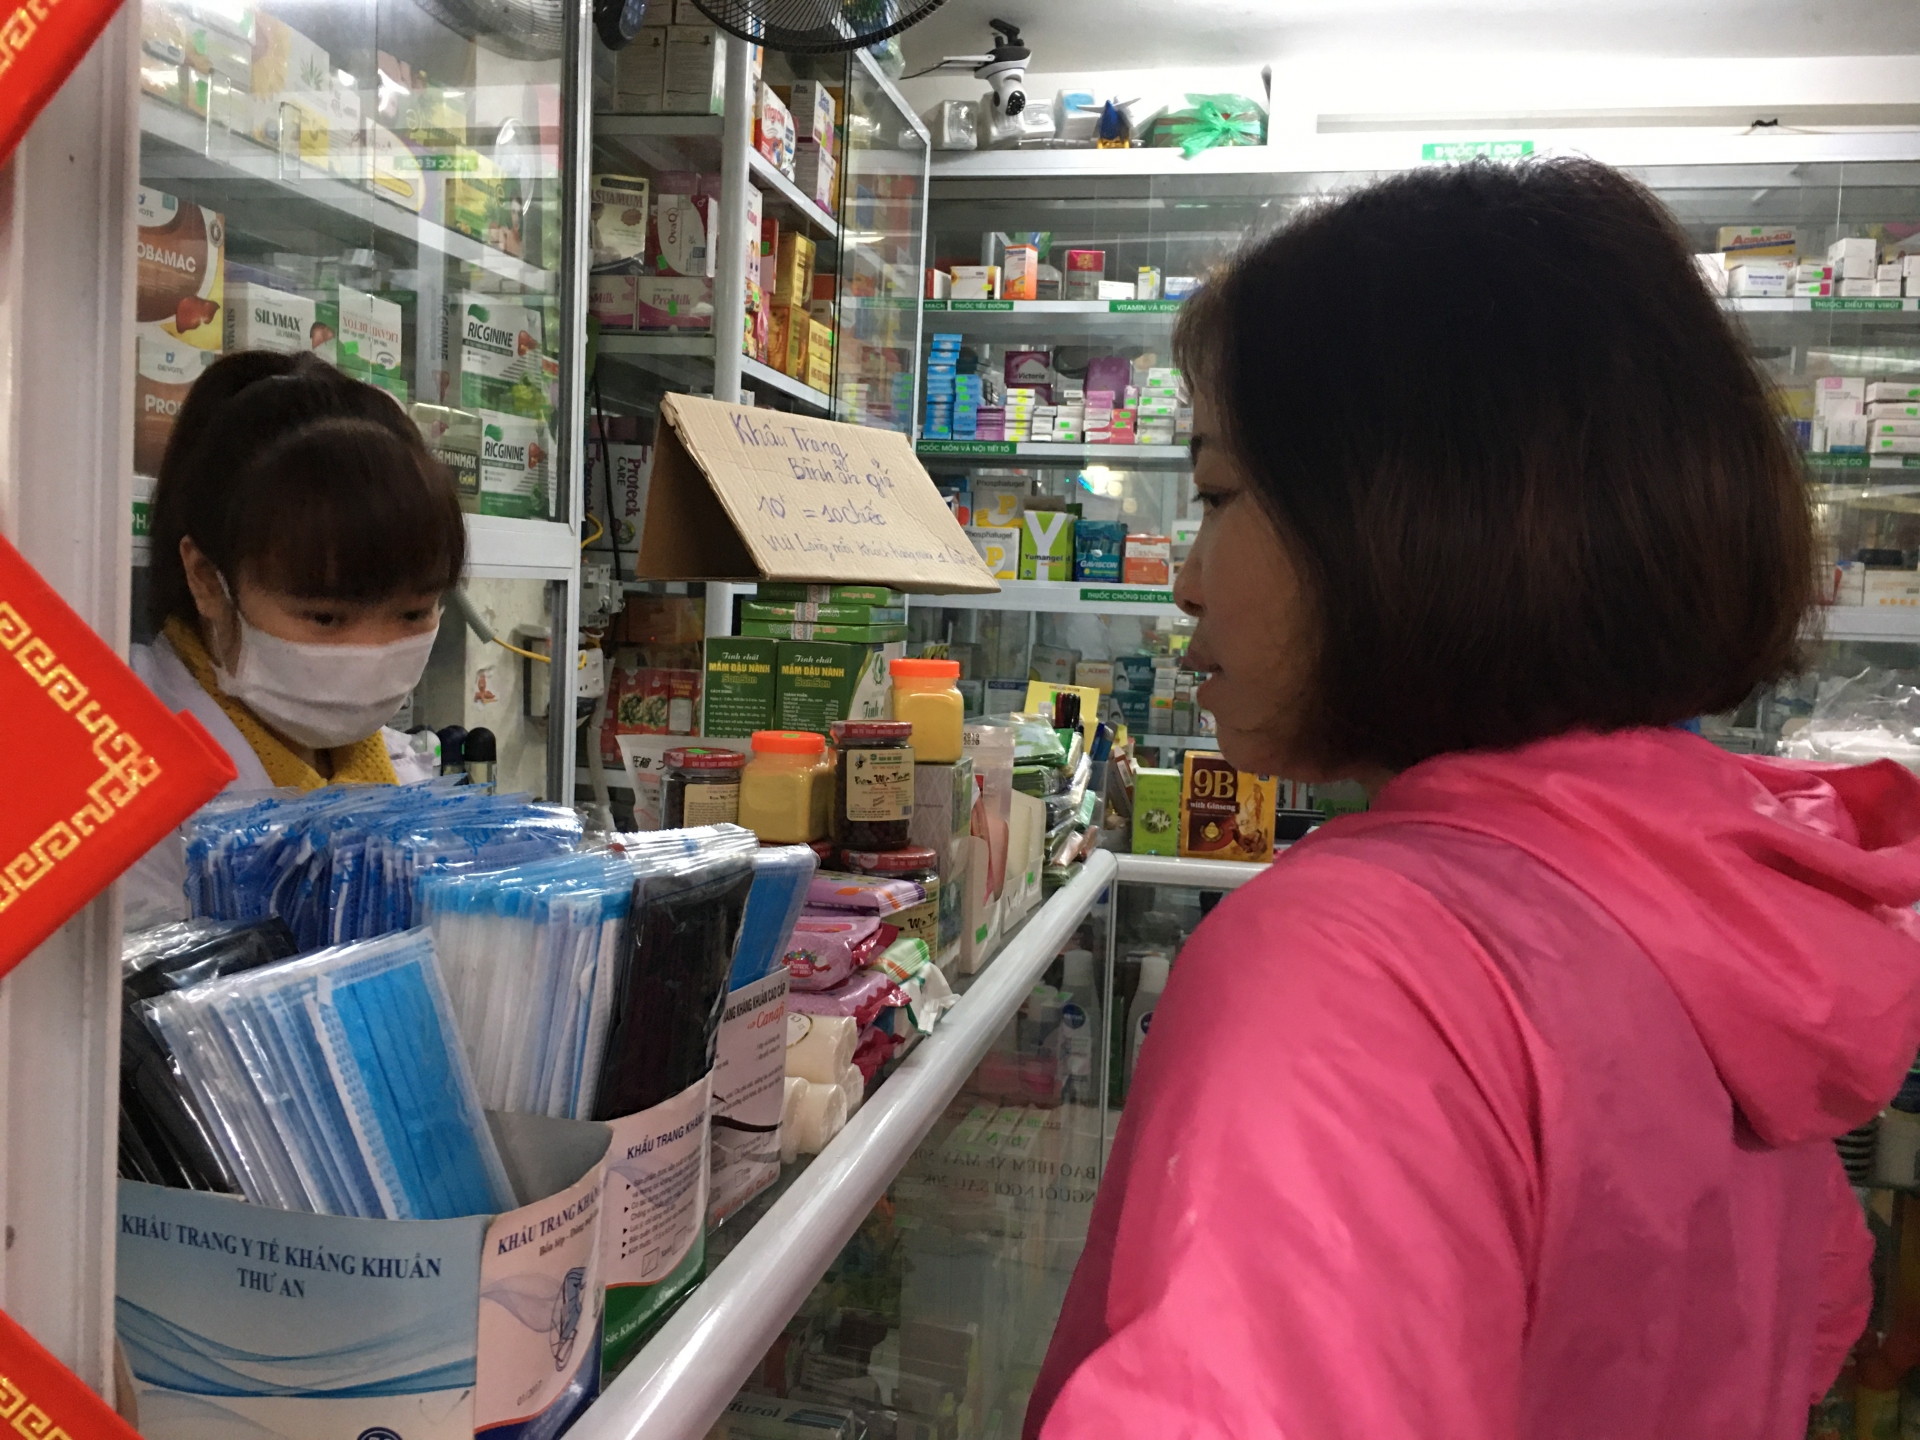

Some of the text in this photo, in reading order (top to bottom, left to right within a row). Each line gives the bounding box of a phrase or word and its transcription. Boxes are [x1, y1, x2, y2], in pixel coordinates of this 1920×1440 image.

[255, 307, 301, 332] SILYMAX
[467, 322, 513, 348] RICGININE
[484, 441, 525, 462] RICGININE
[783, 426, 849, 459] Trang
[617, 456, 627, 487] CARE
[976, 480, 1025, 488] Phosphalugel
[625, 457, 642, 517] Proteck
[1024, 554, 1063, 562] Yumangel
[1080, 560, 1118, 569] GAVISCON
[1193, 768, 1235, 798] 9B
[1190, 801, 1236, 812] with Ginseng
[736, 997, 753, 1016] KHÁNG
[768, 989, 777, 1001] CAO
[627, 1134, 654, 1160] KHẨU
[656, 1125, 685, 1149] TRANG
[497, 1203, 576, 1256] KHẨU TRANG
[121, 1213, 442, 1279] KHẨU TRANG Y TẾ KHÁNG KHUẨN
[237, 1267, 306, 1298] THƯ AN
